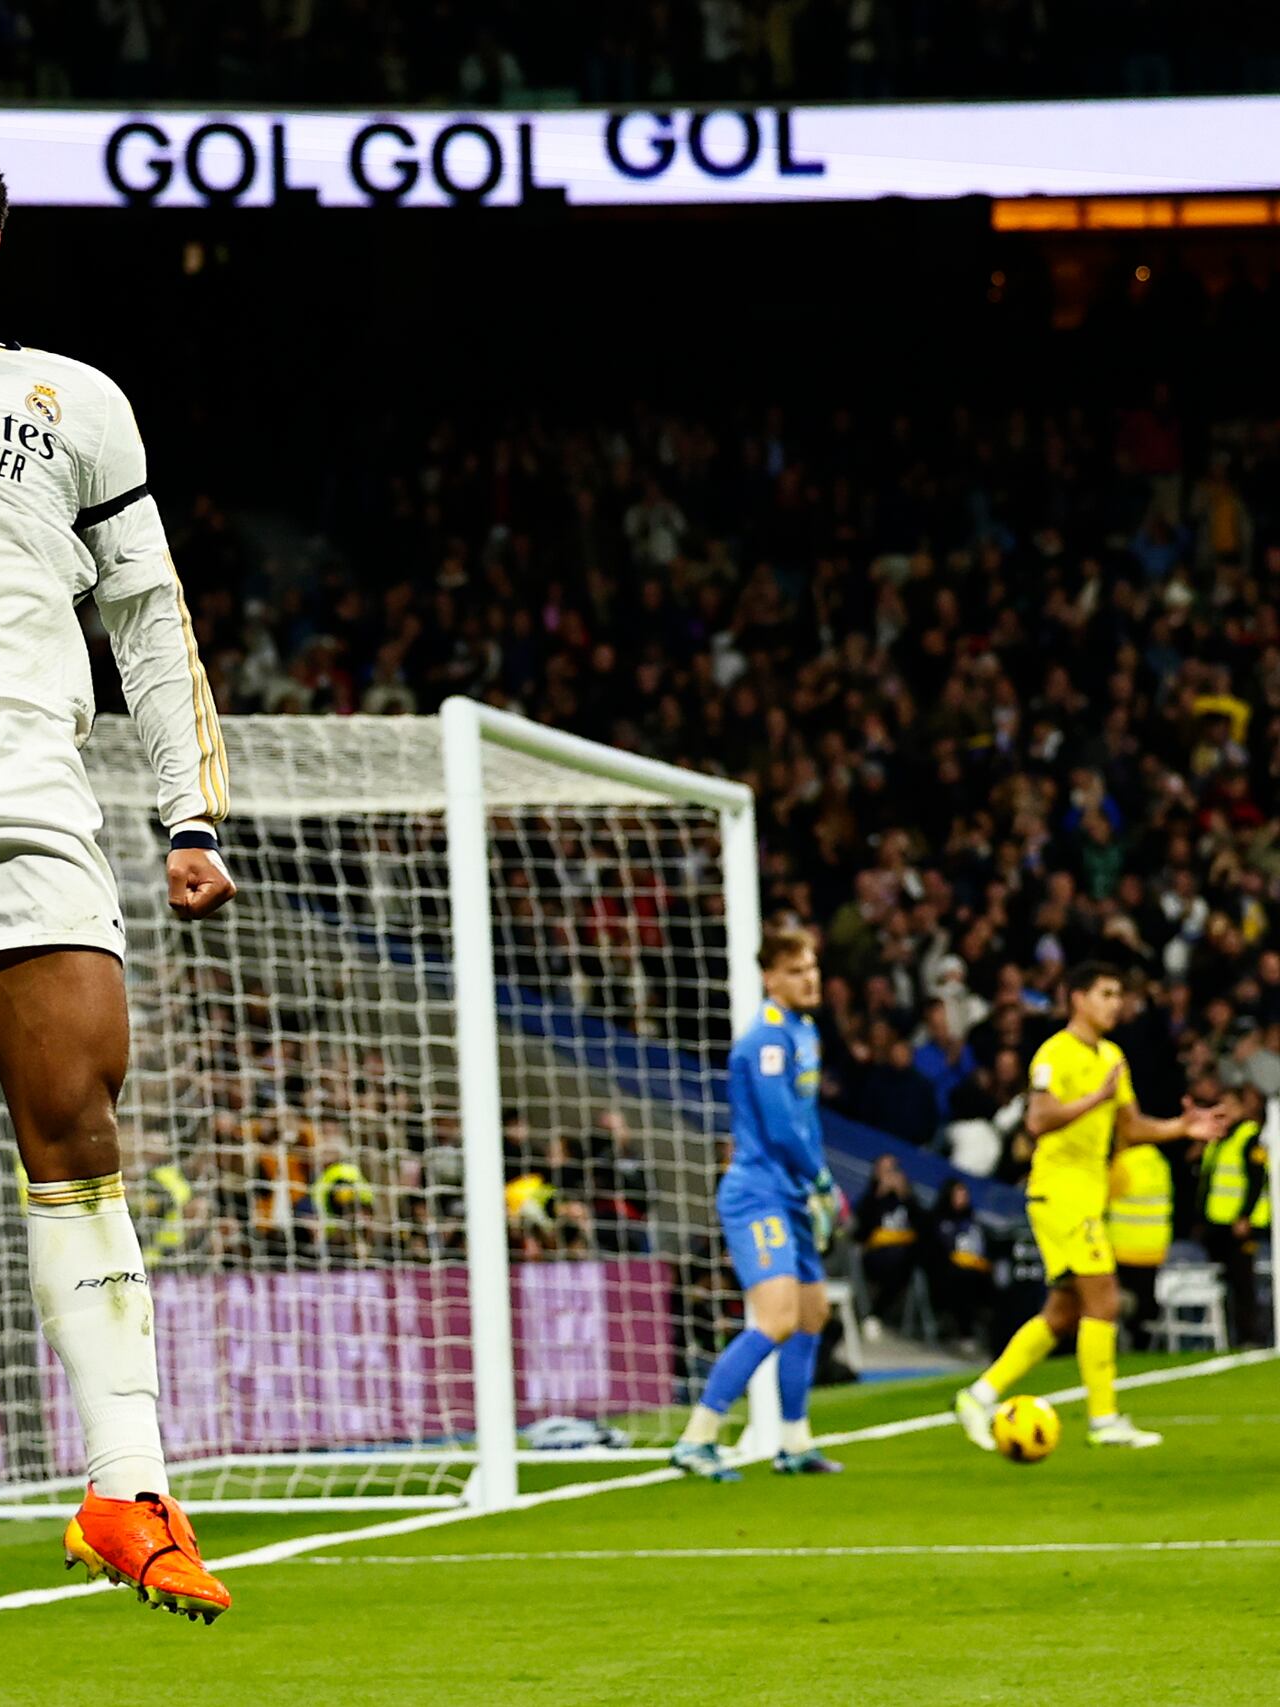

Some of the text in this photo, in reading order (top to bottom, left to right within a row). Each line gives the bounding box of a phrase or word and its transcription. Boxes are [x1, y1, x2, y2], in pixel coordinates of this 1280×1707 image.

[105, 109, 827, 207] GOL GOL GOL
[749, 1216, 787, 1249] 13
[74, 1271, 148, 1291] RMC
